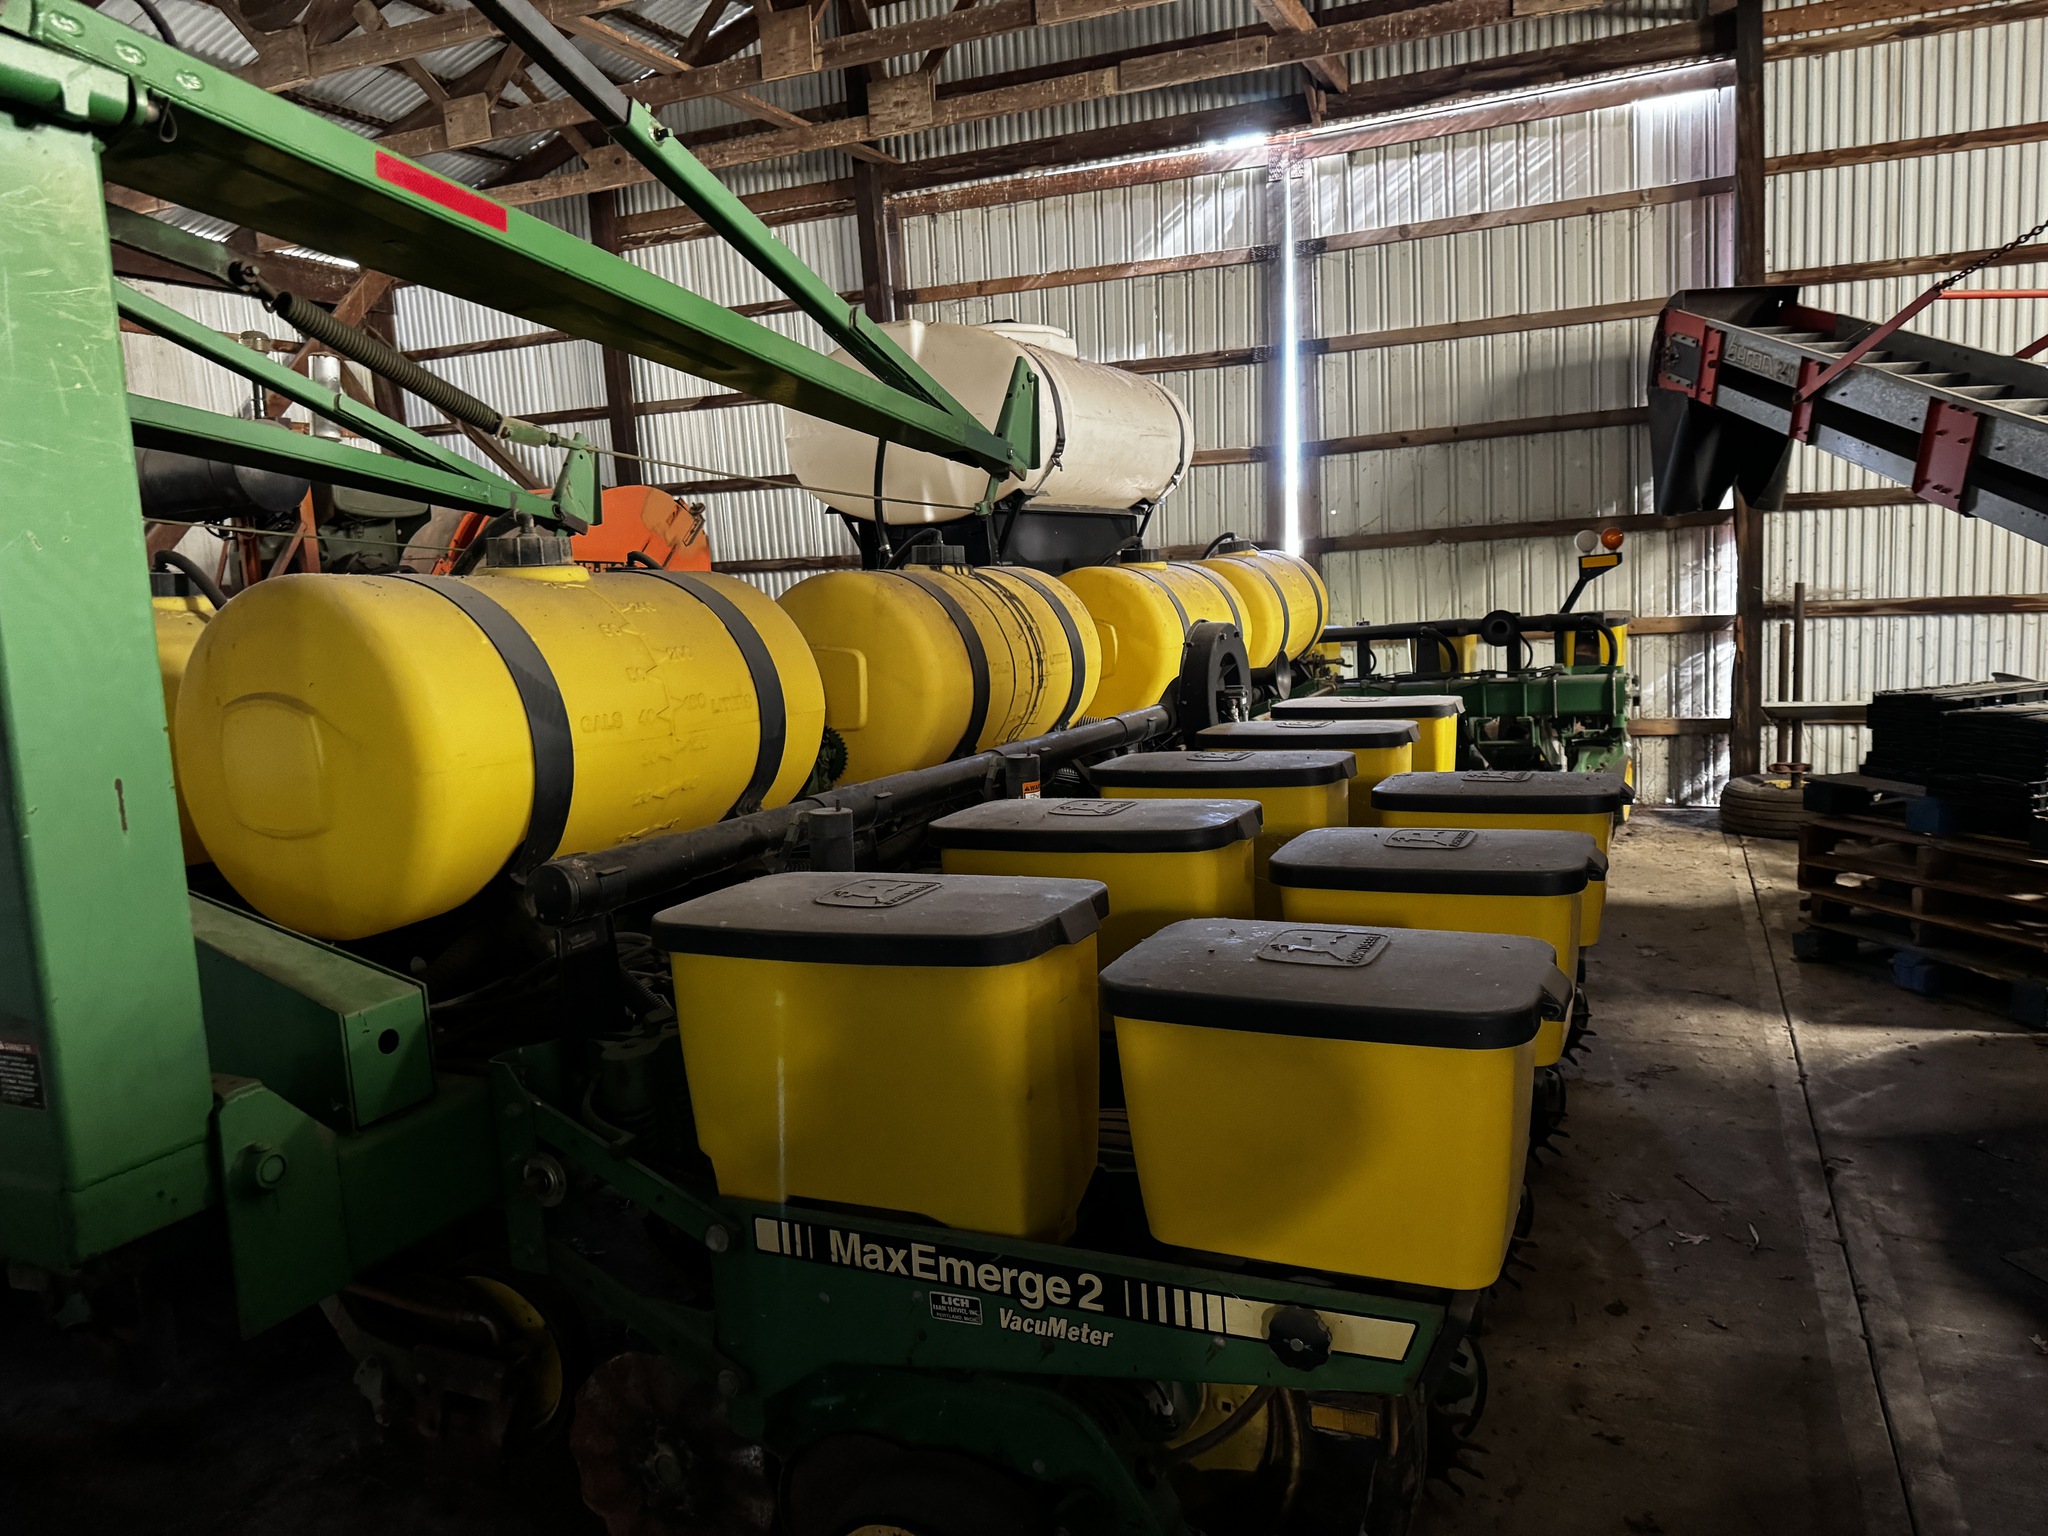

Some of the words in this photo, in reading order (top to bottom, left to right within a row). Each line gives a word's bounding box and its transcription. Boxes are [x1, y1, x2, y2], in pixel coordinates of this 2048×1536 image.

[829, 1229, 1071, 1310] MaxEmerge
[1077, 1273, 1105, 1312] 2
[941, 1296, 970, 1308] LICH
[1000, 1308, 1114, 1347] VacuMeter
